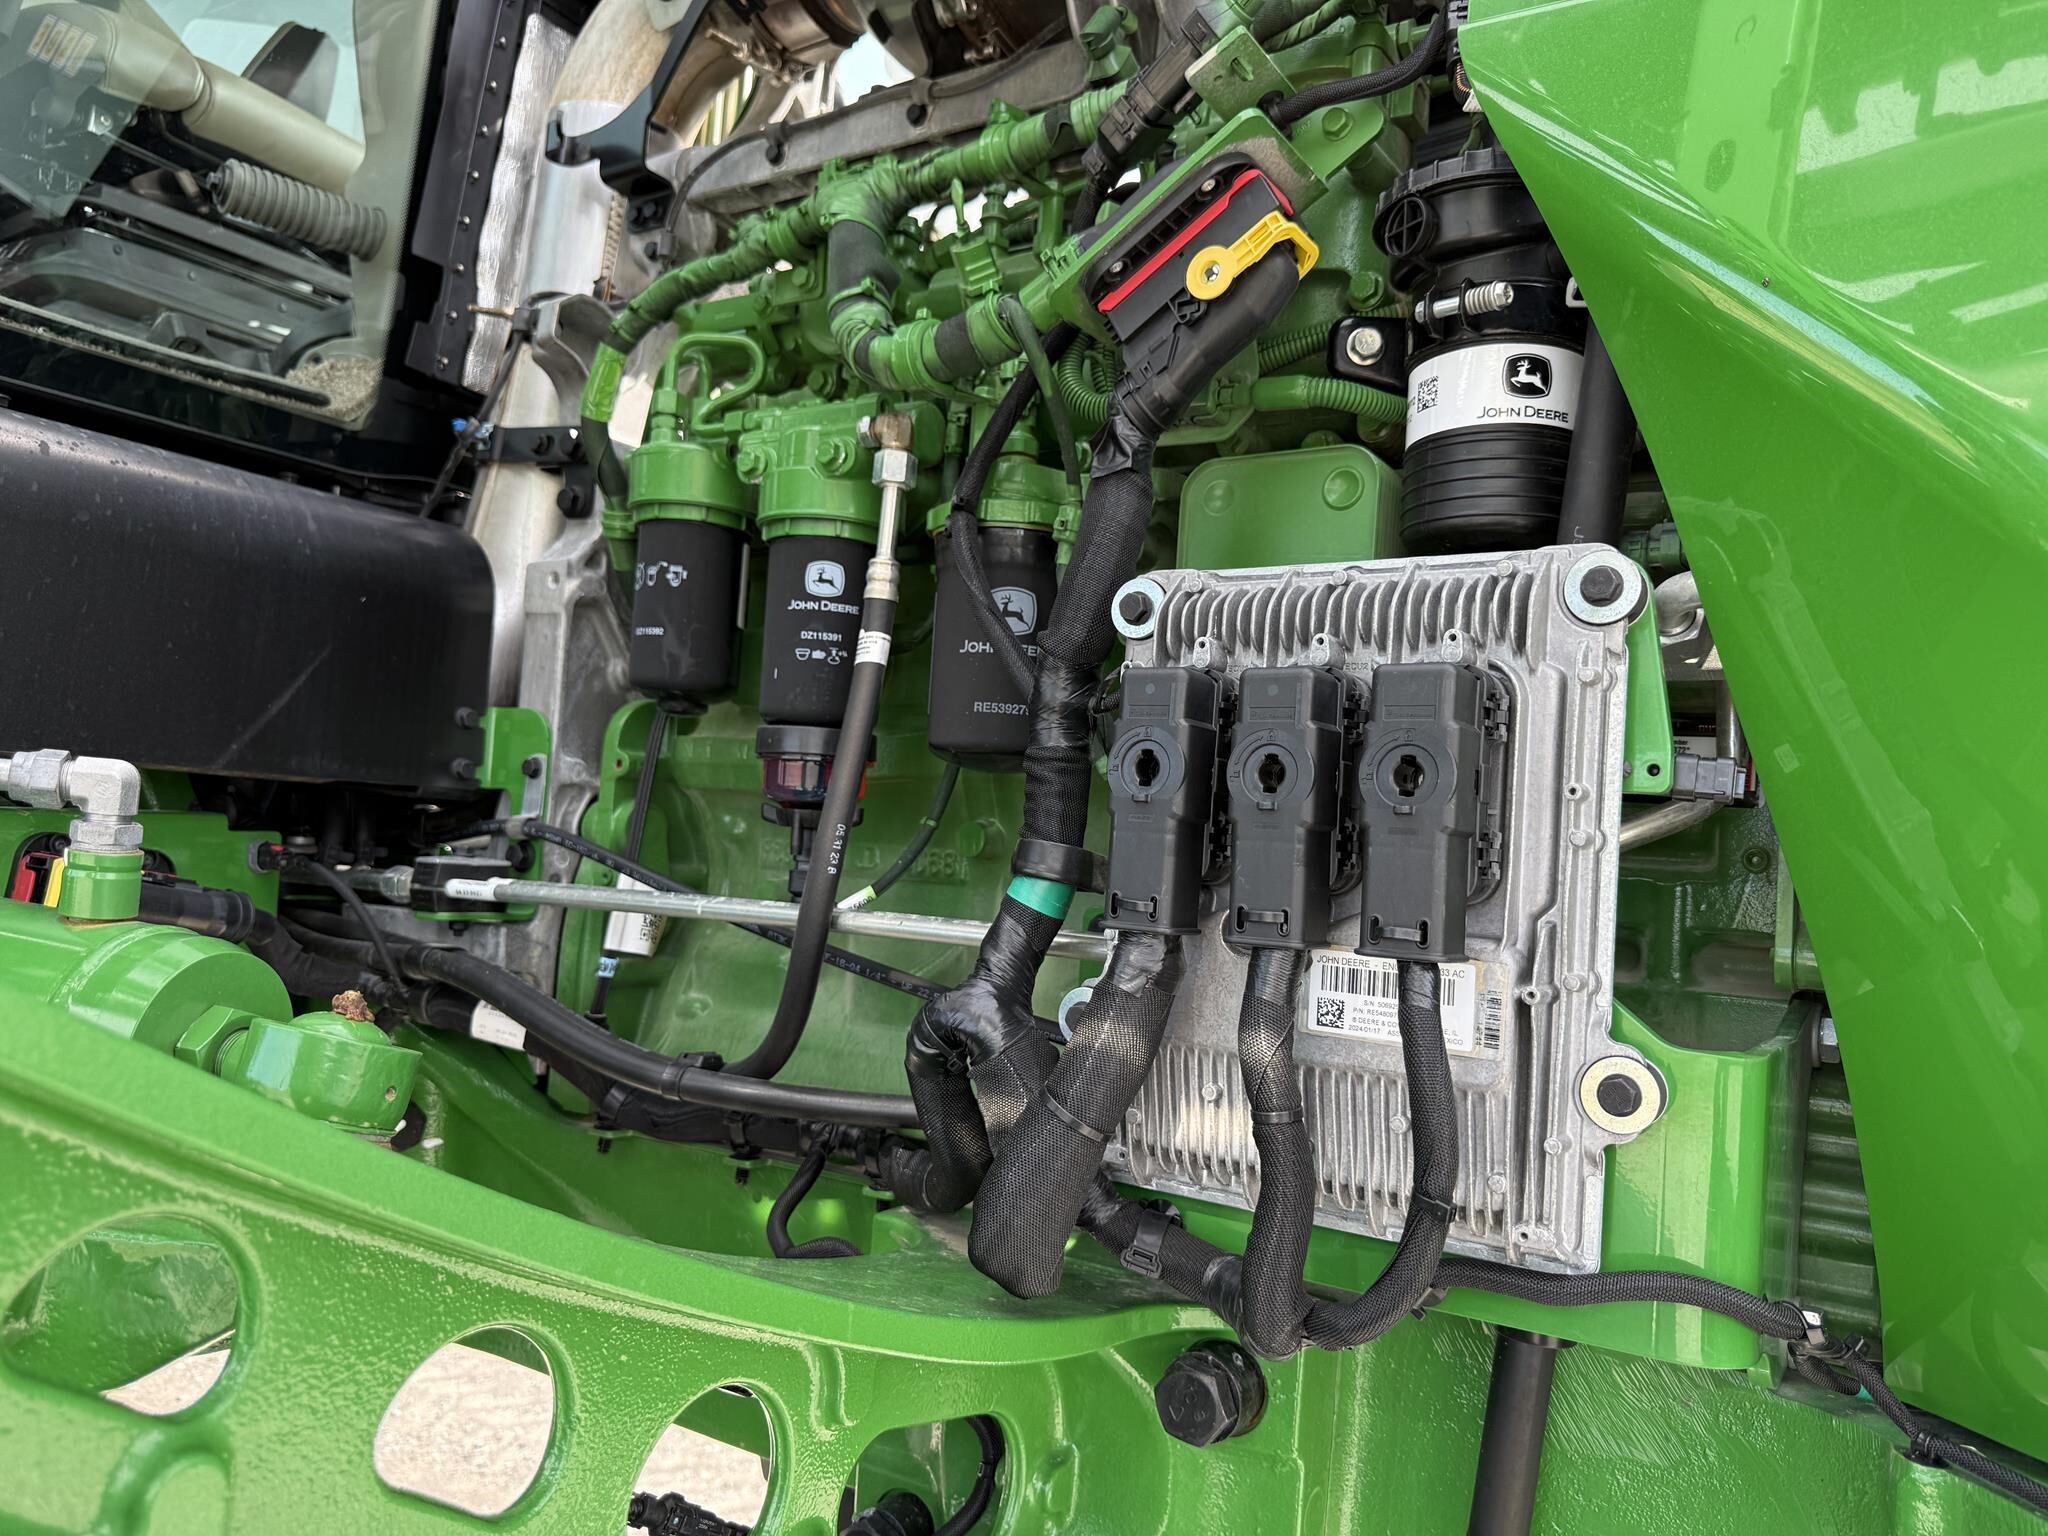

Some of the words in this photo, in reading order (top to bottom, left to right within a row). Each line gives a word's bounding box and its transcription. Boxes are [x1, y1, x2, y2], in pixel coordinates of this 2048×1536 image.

[1476, 406, 1521, 419] JOHN
[1524, 406, 1569, 423] DEERE
[787, 599, 819, 611] JOHN
[820, 600, 860, 615] DEERE
[800, 631, 842, 642] DZ115391
[959, 640, 994, 653] JOH
[1316, 954, 1340, 965] JOHN
[1341, 957, 1371, 969] DEERE
[1452, 969, 1465, 979] AC
[1358, 1017, 1380, 1026] DEERE
